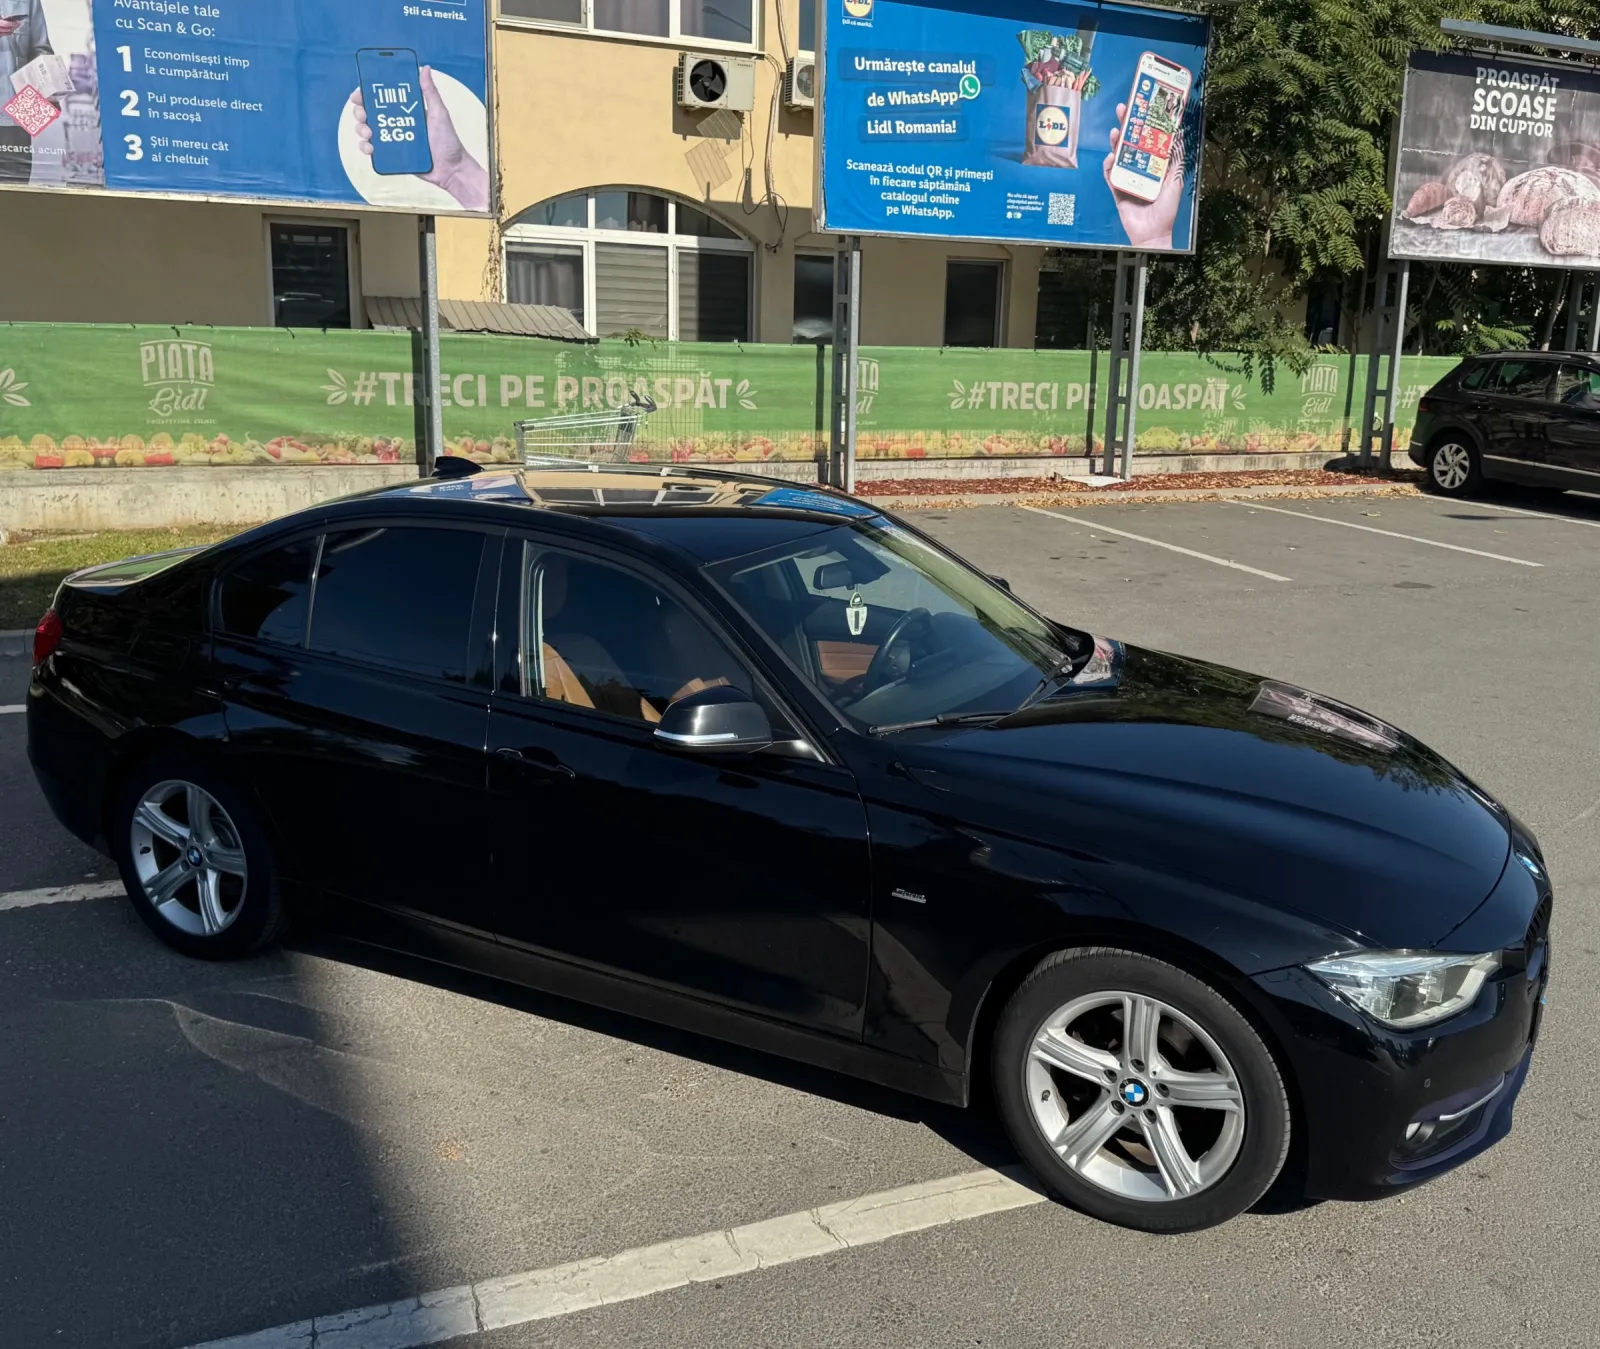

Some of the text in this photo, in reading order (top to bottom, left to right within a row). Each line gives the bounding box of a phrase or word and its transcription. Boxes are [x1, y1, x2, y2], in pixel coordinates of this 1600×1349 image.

[114, 0, 220, 18] Avantajele tale
[403, 5, 467, 21] Știi că merită.
[115, 17, 216, 37] cu Scan & Go:
[116, 45, 250, 73] 1 Economisești timp
[854, 56, 976, 76] Urmărește canalul
[145, 64, 229, 81] la cumpărături
[1475, 66, 1560, 95] PROASPĂT
[119, 89, 264, 117] 2 Pui produsele direct
[867, 89, 959, 107] de WhatsApp
[1472, 88, 1557, 121] SCOASE
[147, 108, 202, 124] în sacoșă
[377, 113, 416, 127] Scan
[380, 127, 415, 142] &Go
[867, 119, 957, 134] Lidl Romania!
[1470, 113, 1553, 138] DIN CUPTOR
[38, 146, 67, 155] acum
[123, 133, 230, 161] 3 Știi mereu cât
[151, 152, 209, 165] ai cheltuit
[846, 159, 994, 182] Scanează codul QR și primești
[869, 175, 971, 192] în fiecare săptămână
[881, 191, 960, 205] catalogul online
[886, 205, 955, 220] pe WhatsApp.
[501, 373, 546, 408] PE
[554, 370, 733, 409] PROASPĂT
[967, 378, 1230, 411] #TRECI PE OASPĂT
[148, 386, 209, 417] Lidl
